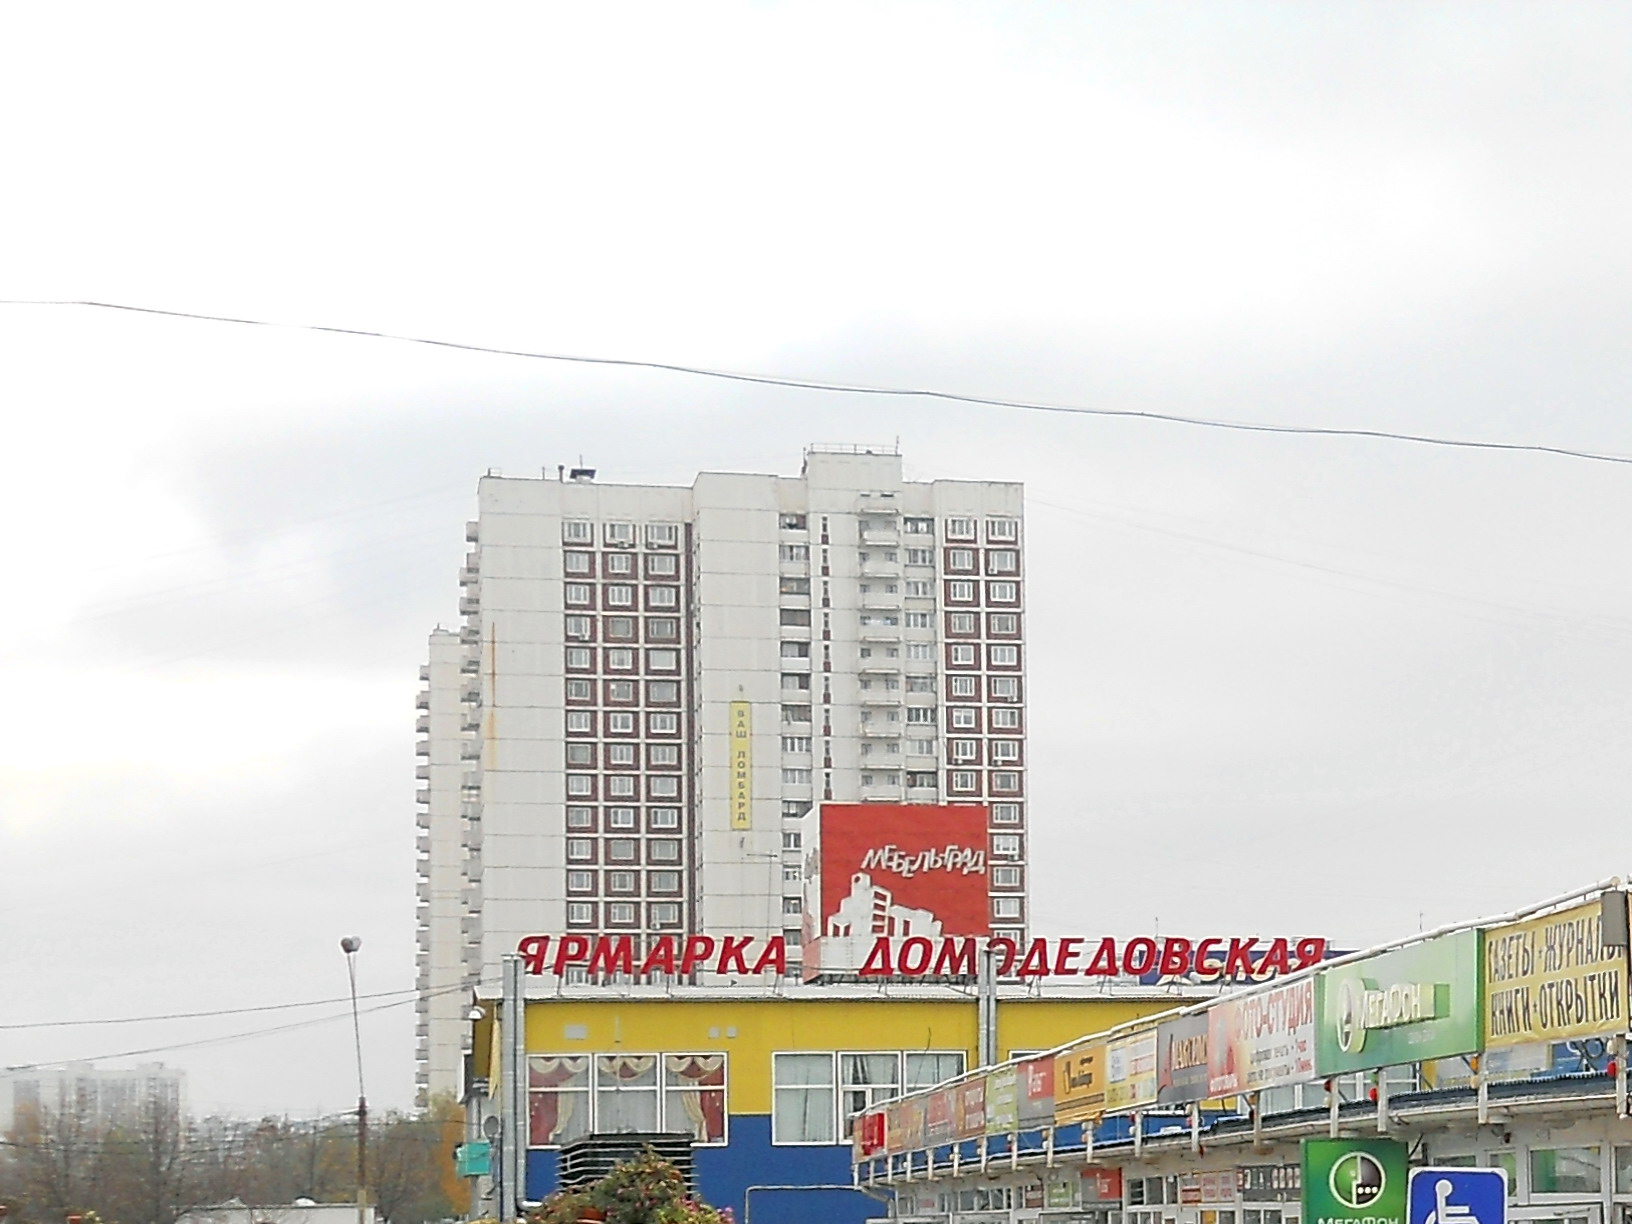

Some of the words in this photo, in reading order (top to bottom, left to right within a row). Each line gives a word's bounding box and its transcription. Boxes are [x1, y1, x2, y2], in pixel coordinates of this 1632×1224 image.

[735, 710, 747, 738] ВАШ
[736, 751, 747, 821] ЛОМБАРД
[860, 845, 986, 877] МЕБЕЛЬГРАД
[517, 936, 786, 976] ЯРМАРКА
[858, 937, 1326, 977] ДОМОДЕДОВСКАЯ
[1488, 931, 1536, 984] ГАЗЕТЫ
[1543, 914, 1622, 974] ЖУРНАЛ
[1491, 986, 1532, 1037] КНИГИ
[1540, 970, 1620, 1030] ОТКРЫТКИ
